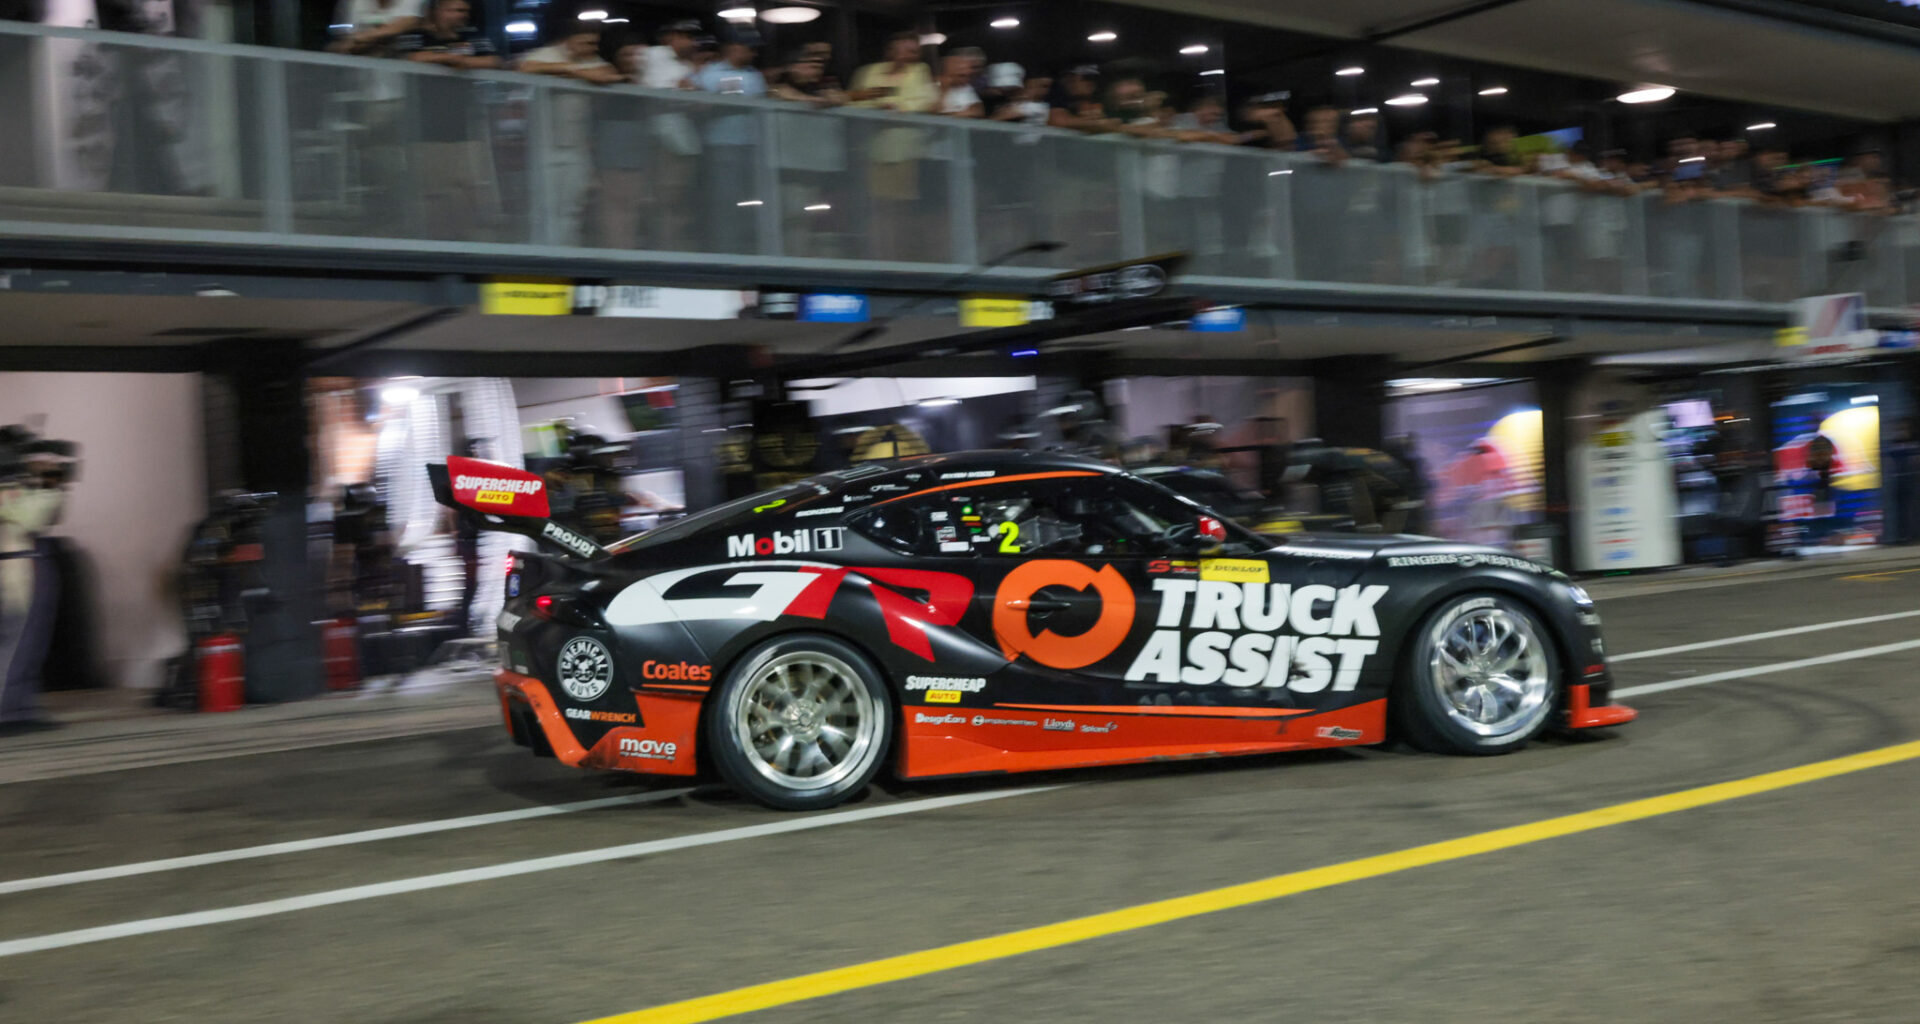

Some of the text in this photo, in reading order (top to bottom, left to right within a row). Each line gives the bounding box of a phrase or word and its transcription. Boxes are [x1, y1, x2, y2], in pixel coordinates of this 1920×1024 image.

[455, 475, 542, 494] SUPERCHEAP
[480, 493, 509, 502] AUTO
[727, 529, 811, 558] Mobil
[999, 521, 1020, 553] 2
[1213, 565, 1266, 573] DUNLOP
[1387, 554, 1458, 567] RINGERS
[1152, 578, 1389, 637] TRUCK
[561, 641, 607, 673] CHEMICAL
[1124, 630, 1379, 693] ASSIST
[642, 660, 712, 681] Coates
[570, 682, 599, 696] GUYS
[905, 675, 986, 693] SUPERCHEAP
[565, 708, 636, 723] GEARWRENCH
[620, 738, 677, 755] move
